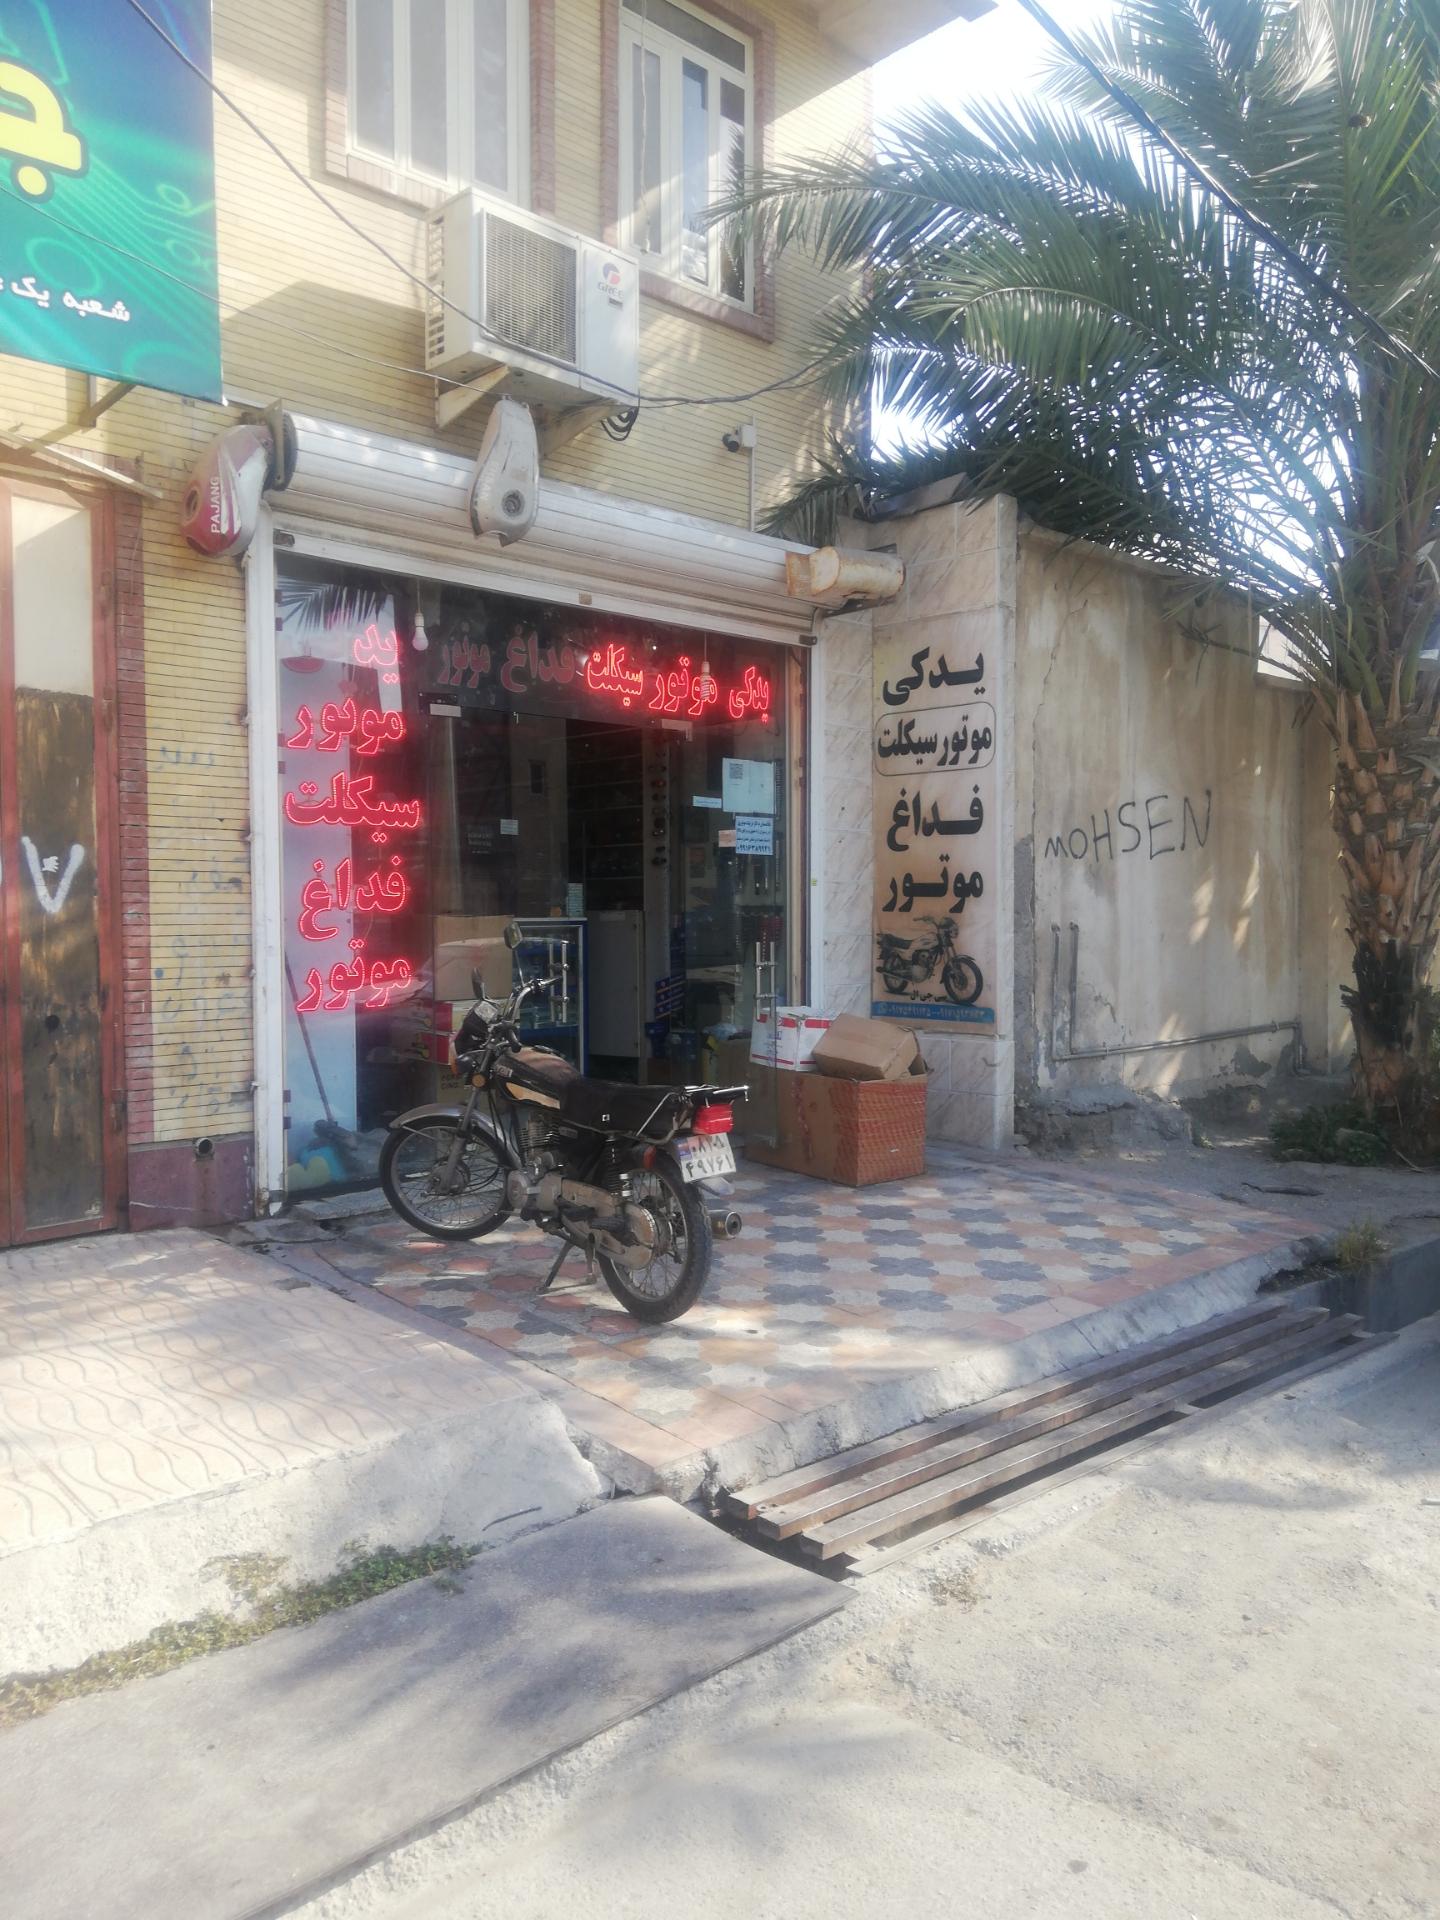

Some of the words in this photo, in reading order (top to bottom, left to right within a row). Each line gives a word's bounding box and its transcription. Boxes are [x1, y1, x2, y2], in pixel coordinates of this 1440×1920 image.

[11, 277, 49, 308] یک
[63, 292, 130, 321] شعبه
[586, 642, 645, 707] سیکلت
[648, 656, 718, 716] موتور
[729, 666, 769, 724] یدکی
[882, 646, 986, 706] یدکی
[286, 771, 422, 843] سیکلت
[886, 784, 984, 852] فداغ
[1044, 789, 1212, 863] MOHSEN
[299, 855, 407, 941] فداغ
[881, 853, 984, 914] موتور
[297, 938, 412, 1012] موتور
